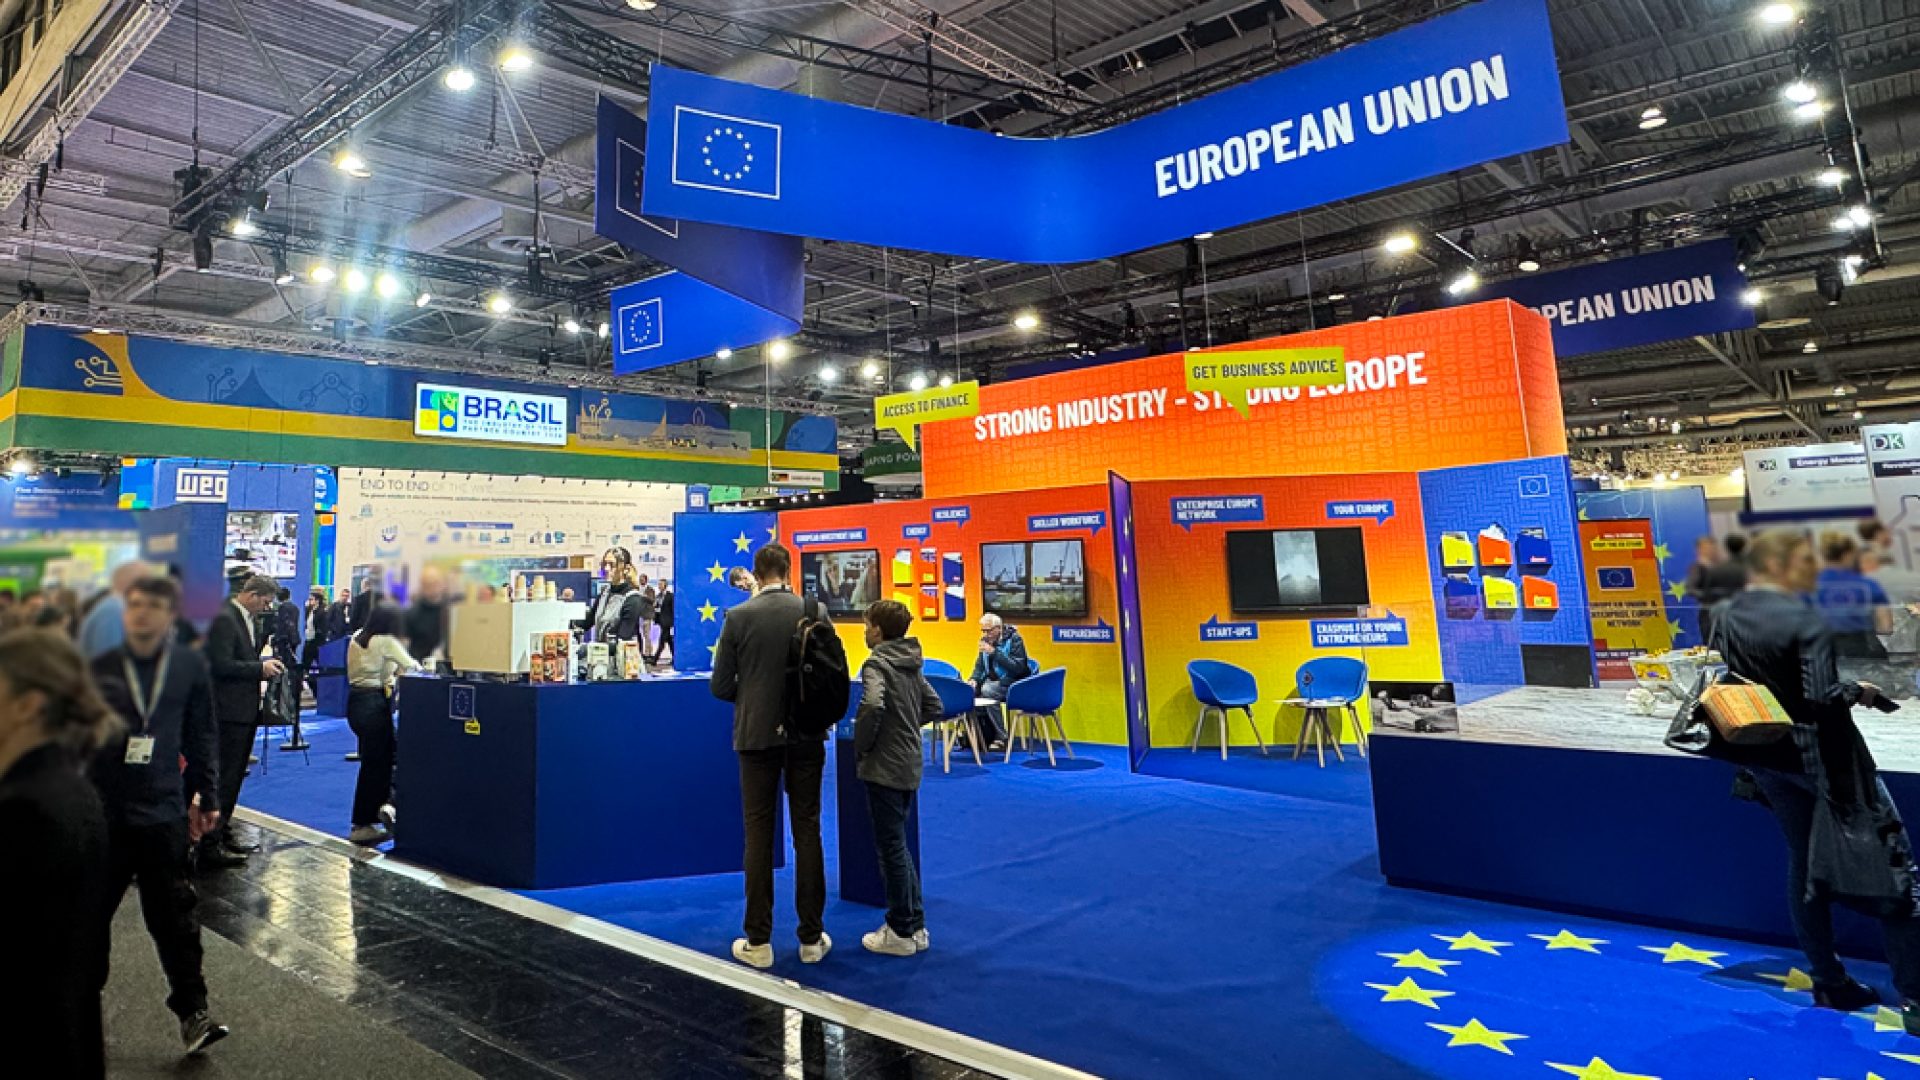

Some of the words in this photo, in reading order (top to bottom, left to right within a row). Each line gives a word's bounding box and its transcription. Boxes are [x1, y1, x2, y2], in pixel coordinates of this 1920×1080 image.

[1155, 102, 1354, 198] EUROPEAN
[1363, 54, 1510, 135] UNION
[1622, 275, 1716, 314] UNION
[1192, 365, 1218, 379] GET
[1222, 362, 1286, 379] BUSINESS
[1290, 358, 1339, 375] ADVICE
[464, 394, 562, 426] BRASIL
[883, 402, 915, 418] ACCESS
[918, 400, 929, 413] TO
[931, 393, 969, 411] FINANCE
[974, 405, 1053, 441] STRONG
[1057, 387, 1167, 430] INDUSTRY
[361, 479, 384, 490] END
[387, 480, 403, 490] TO
[407, 481, 429, 491] END
[1177, 499, 1225, 510] ENTERPRISE
[1227, 498, 1258, 509] EUROPE
[1333, 503, 1355, 515] YOUR
[1357, 503, 1389, 515] EUROPE
[1177, 509, 1217, 520] NETWORK
[1207, 626, 1253, 638] START-UPS
[1316, 623, 1354, 634] ERASMUS
[1355, 623, 1373, 632] FOR
[1374, 622, 1402, 632] YOUNG
